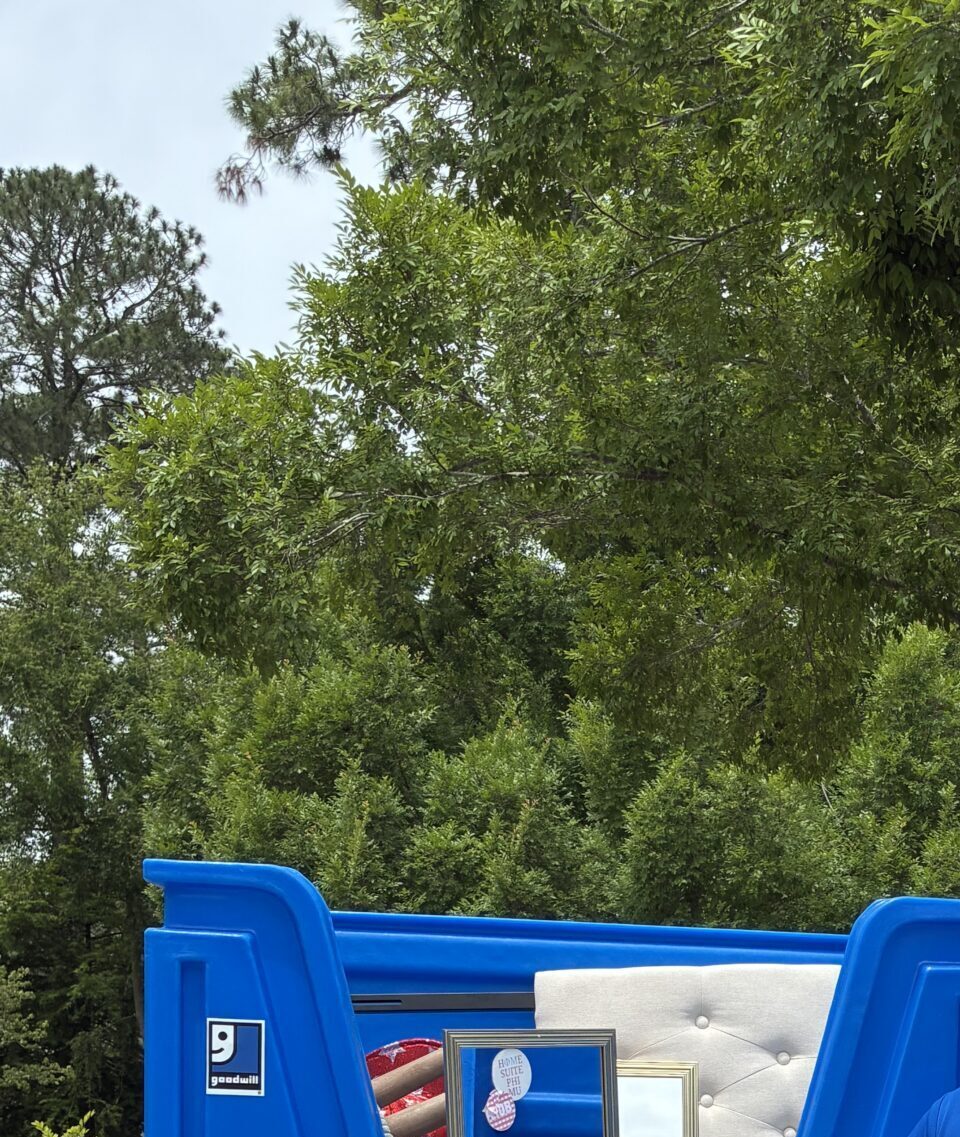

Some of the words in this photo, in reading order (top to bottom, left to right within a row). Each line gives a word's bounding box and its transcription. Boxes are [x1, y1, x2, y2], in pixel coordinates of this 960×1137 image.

[500, 1065, 524, 1078] SUITE
[211, 1074, 258, 1087] goodwill
[506, 1076, 520, 1087] PHI
